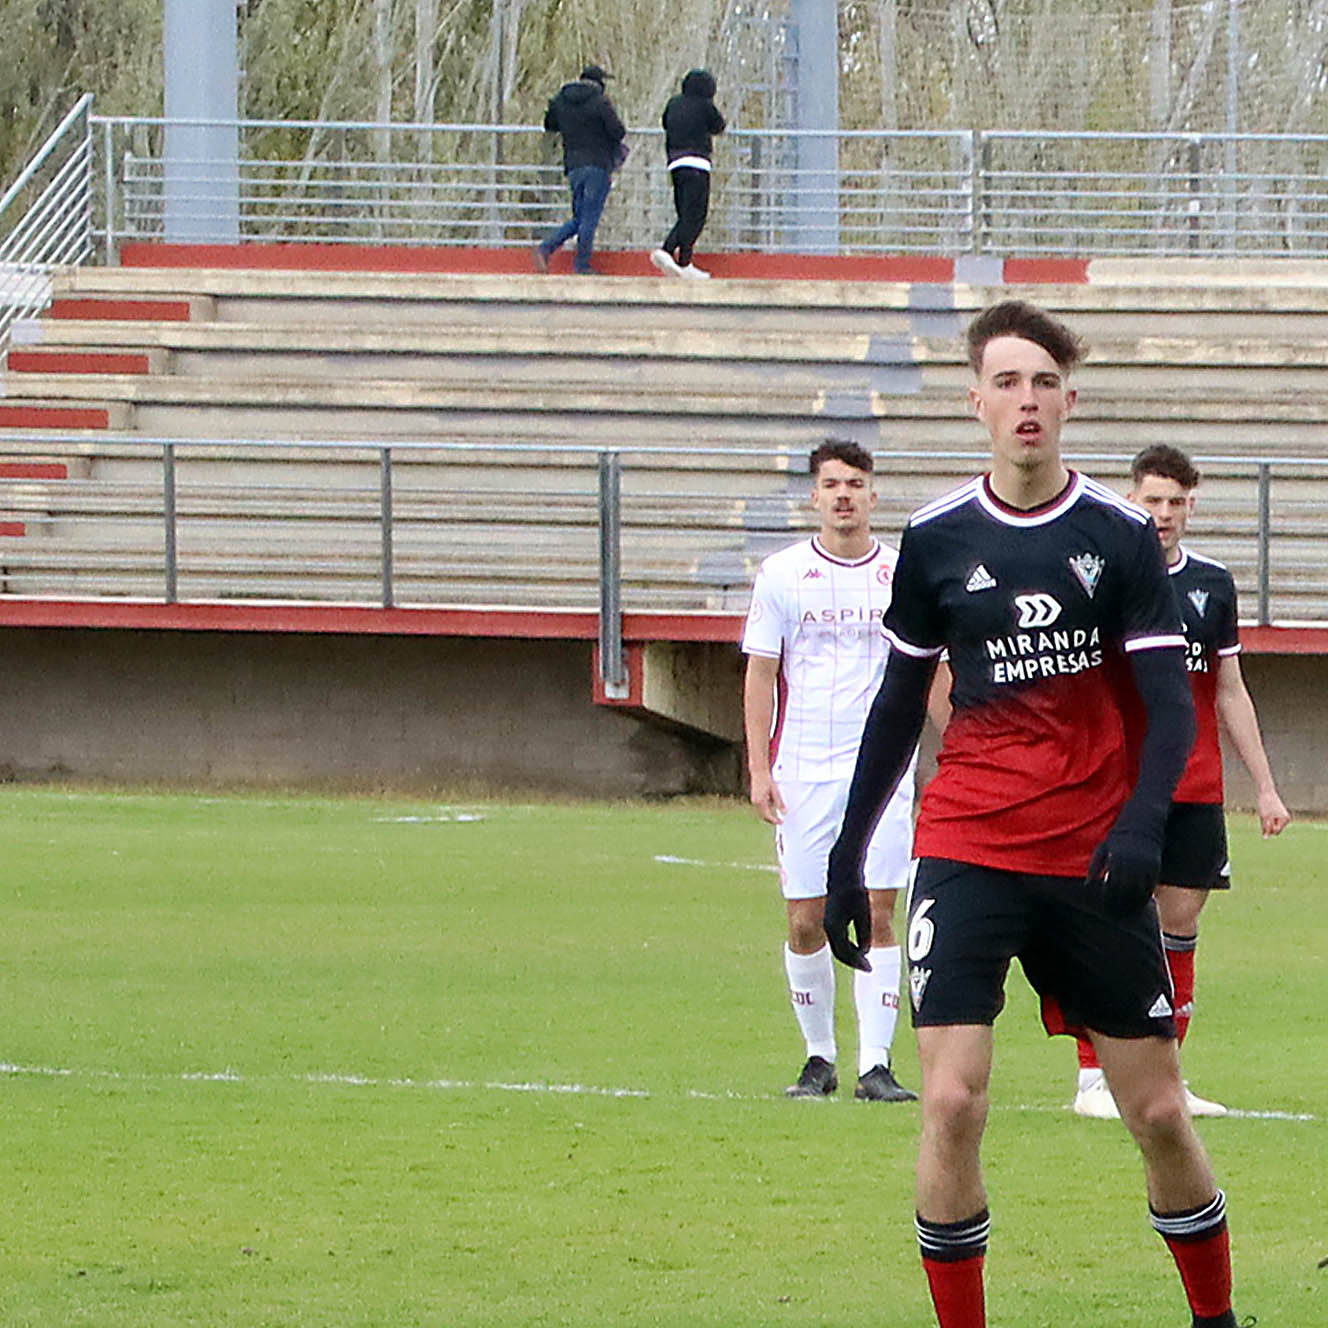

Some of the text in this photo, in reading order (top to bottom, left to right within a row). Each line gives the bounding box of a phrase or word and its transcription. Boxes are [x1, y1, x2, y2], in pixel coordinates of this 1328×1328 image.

[802, 606, 883, 622] ASPIR
[986, 626, 1101, 660] MIRANDA
[994, 650, 1103, 682] EMPRESAS
[908, 898, 936, 962] 6
[882, 992, 900, 1009] CD
